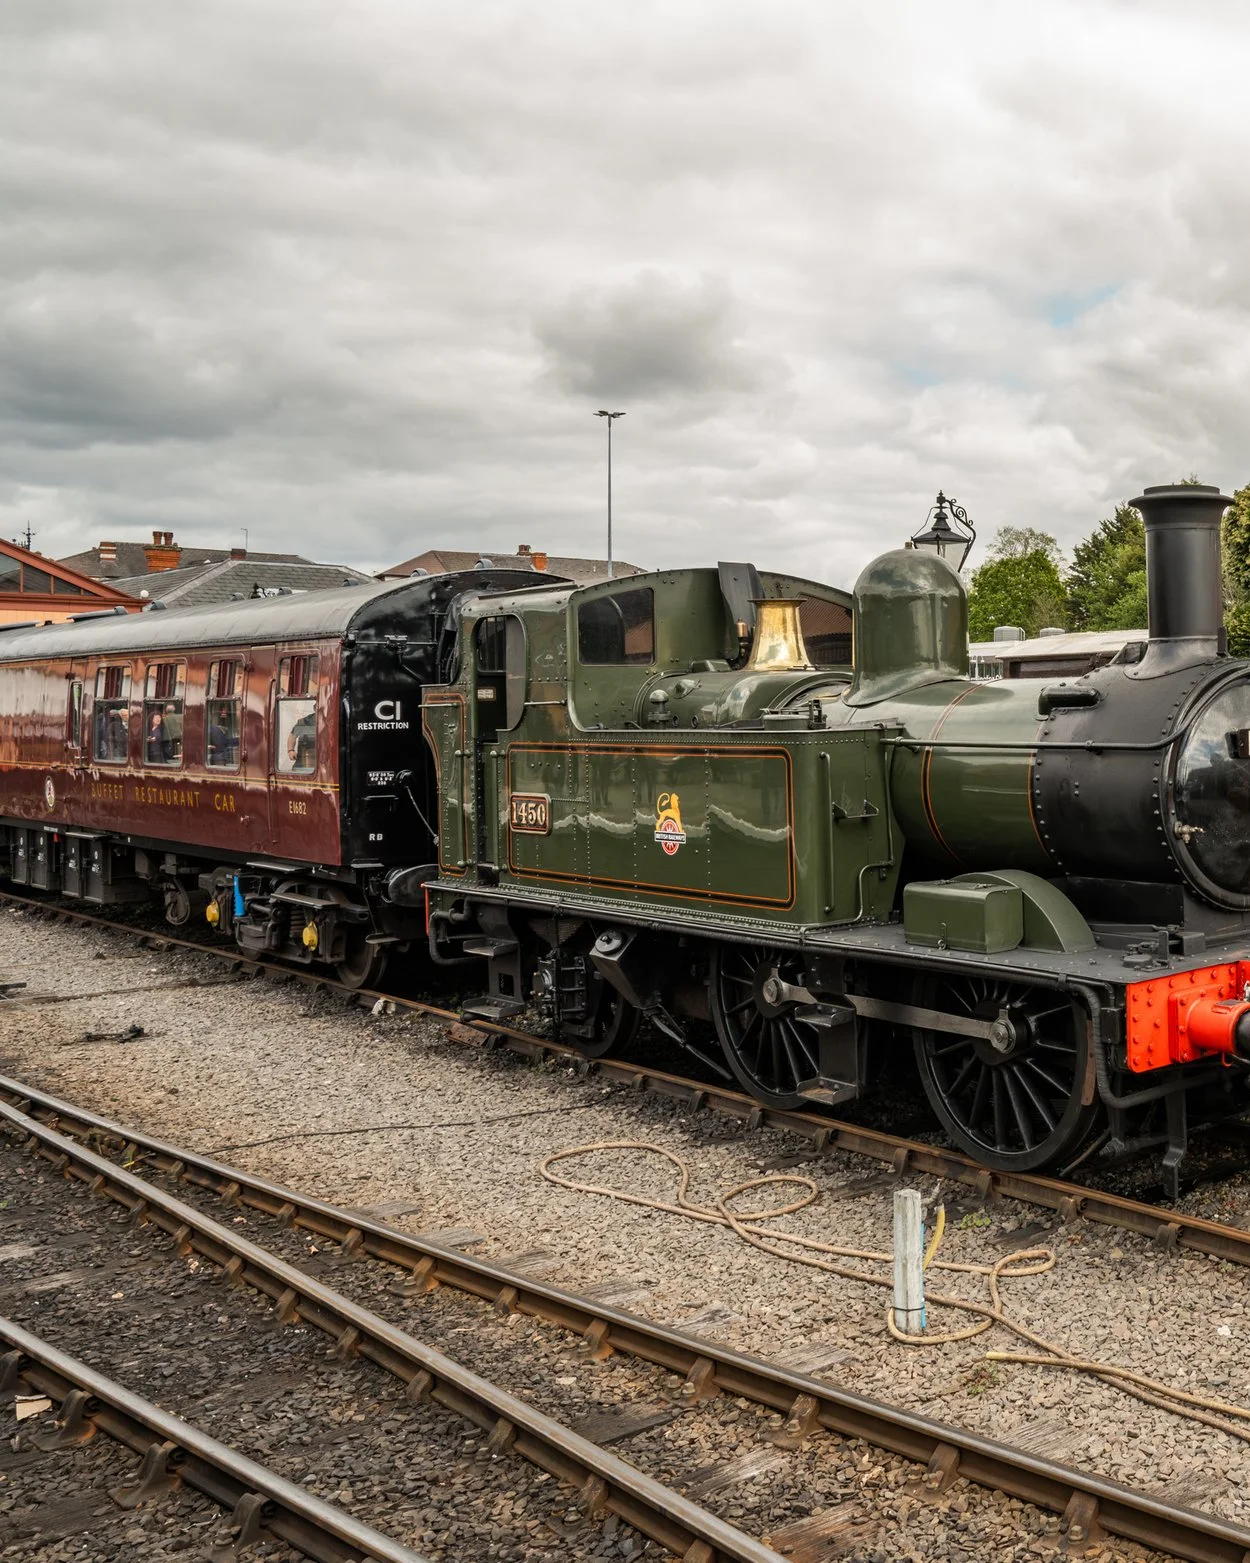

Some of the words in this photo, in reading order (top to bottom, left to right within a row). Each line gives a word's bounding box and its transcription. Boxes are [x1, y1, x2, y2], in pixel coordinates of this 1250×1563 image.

[357, 722, 409, 730] RESTRICTION
[91, 783, 124, 799] BUFFET
[135, 786, 200, 808] RESTAURANT
[214, 793, 236, 812] CAR
[511, 801, 546, 826] 1450
